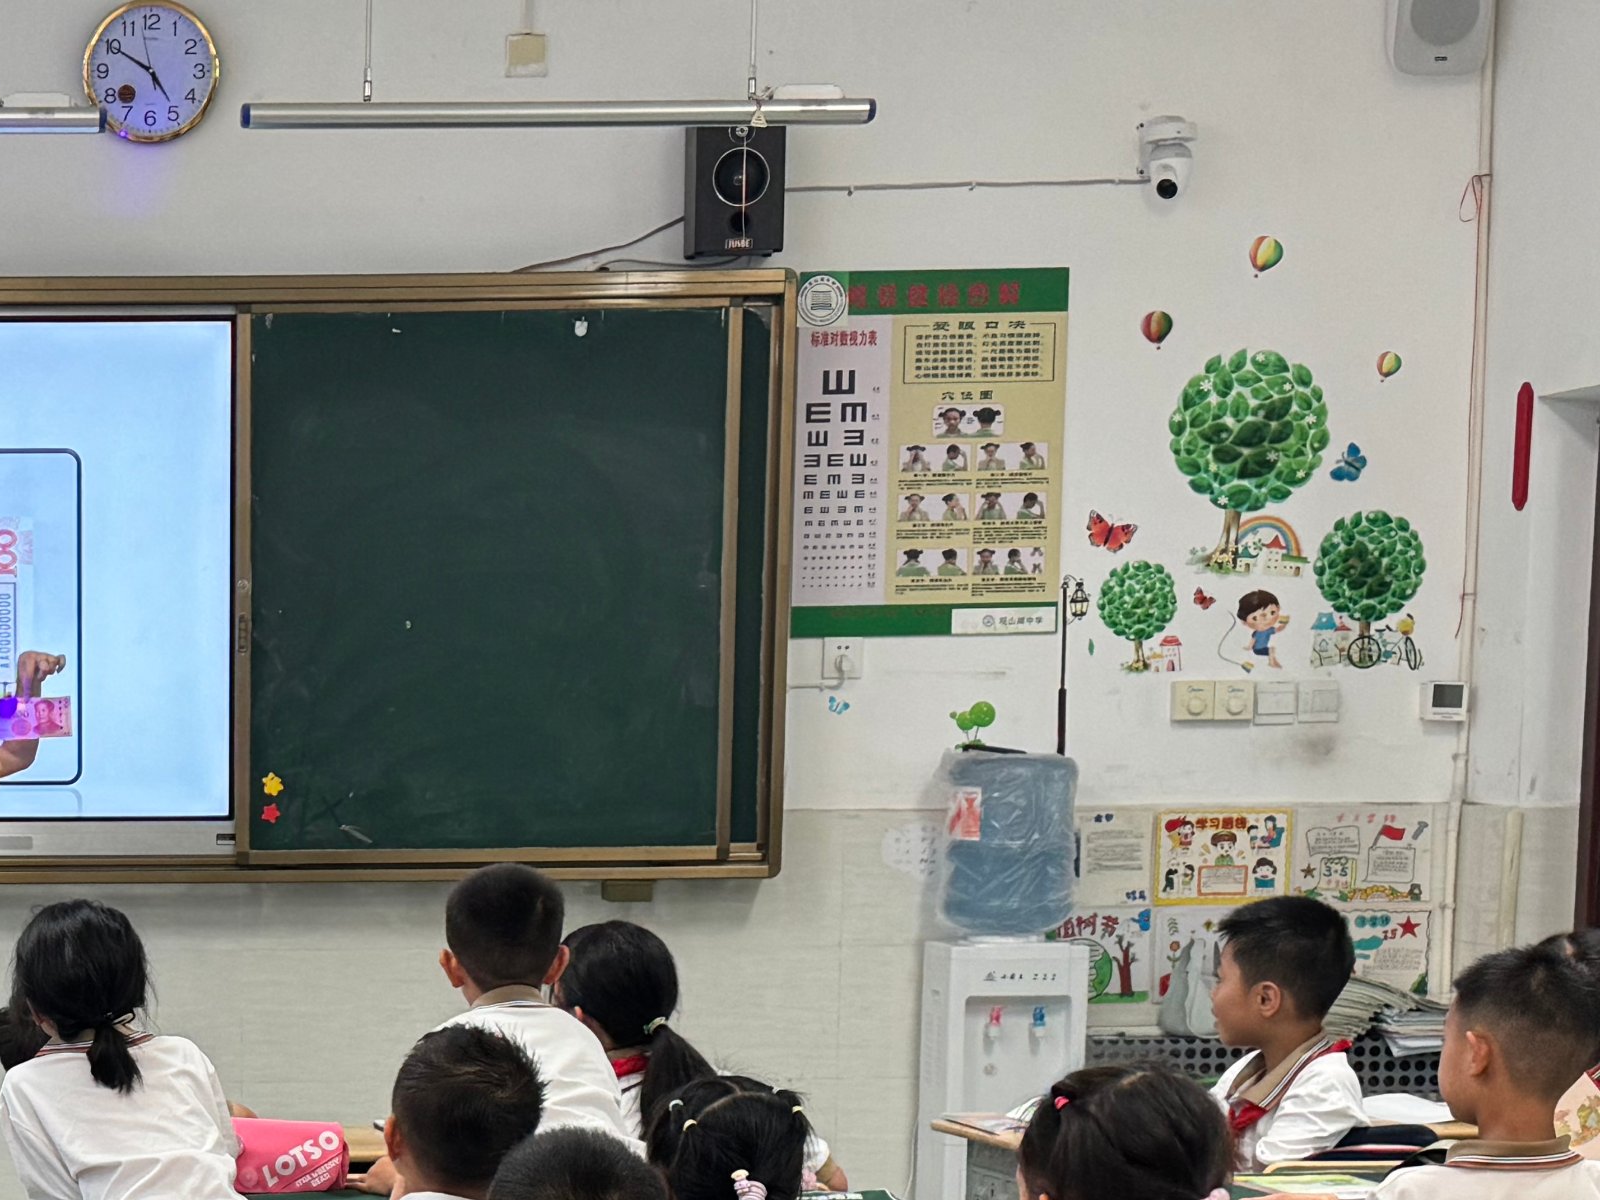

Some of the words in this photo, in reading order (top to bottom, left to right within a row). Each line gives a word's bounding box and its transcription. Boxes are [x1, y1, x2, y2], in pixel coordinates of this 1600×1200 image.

[122, 21, 135, 36] 11
[143, 14, 160, 30] 12
[172, 21, 177, 36] 1
[105, 39, 121, 54] 10
[185, 39, 197, 55] 2
[96, 63, 109, 79] 9
[193, 64, 205, 79] 3
[104, 88, 116, 103] 8
[185, 88, 196, 104] 4
[121, 106, 133, 121] 7
[144, 111, 156, 126] 6
[167, 106, 179, 121] 5
[810, 330, 878, 347] 标准对数视力表
[261, 1130, 340, 1188] LOTSO
